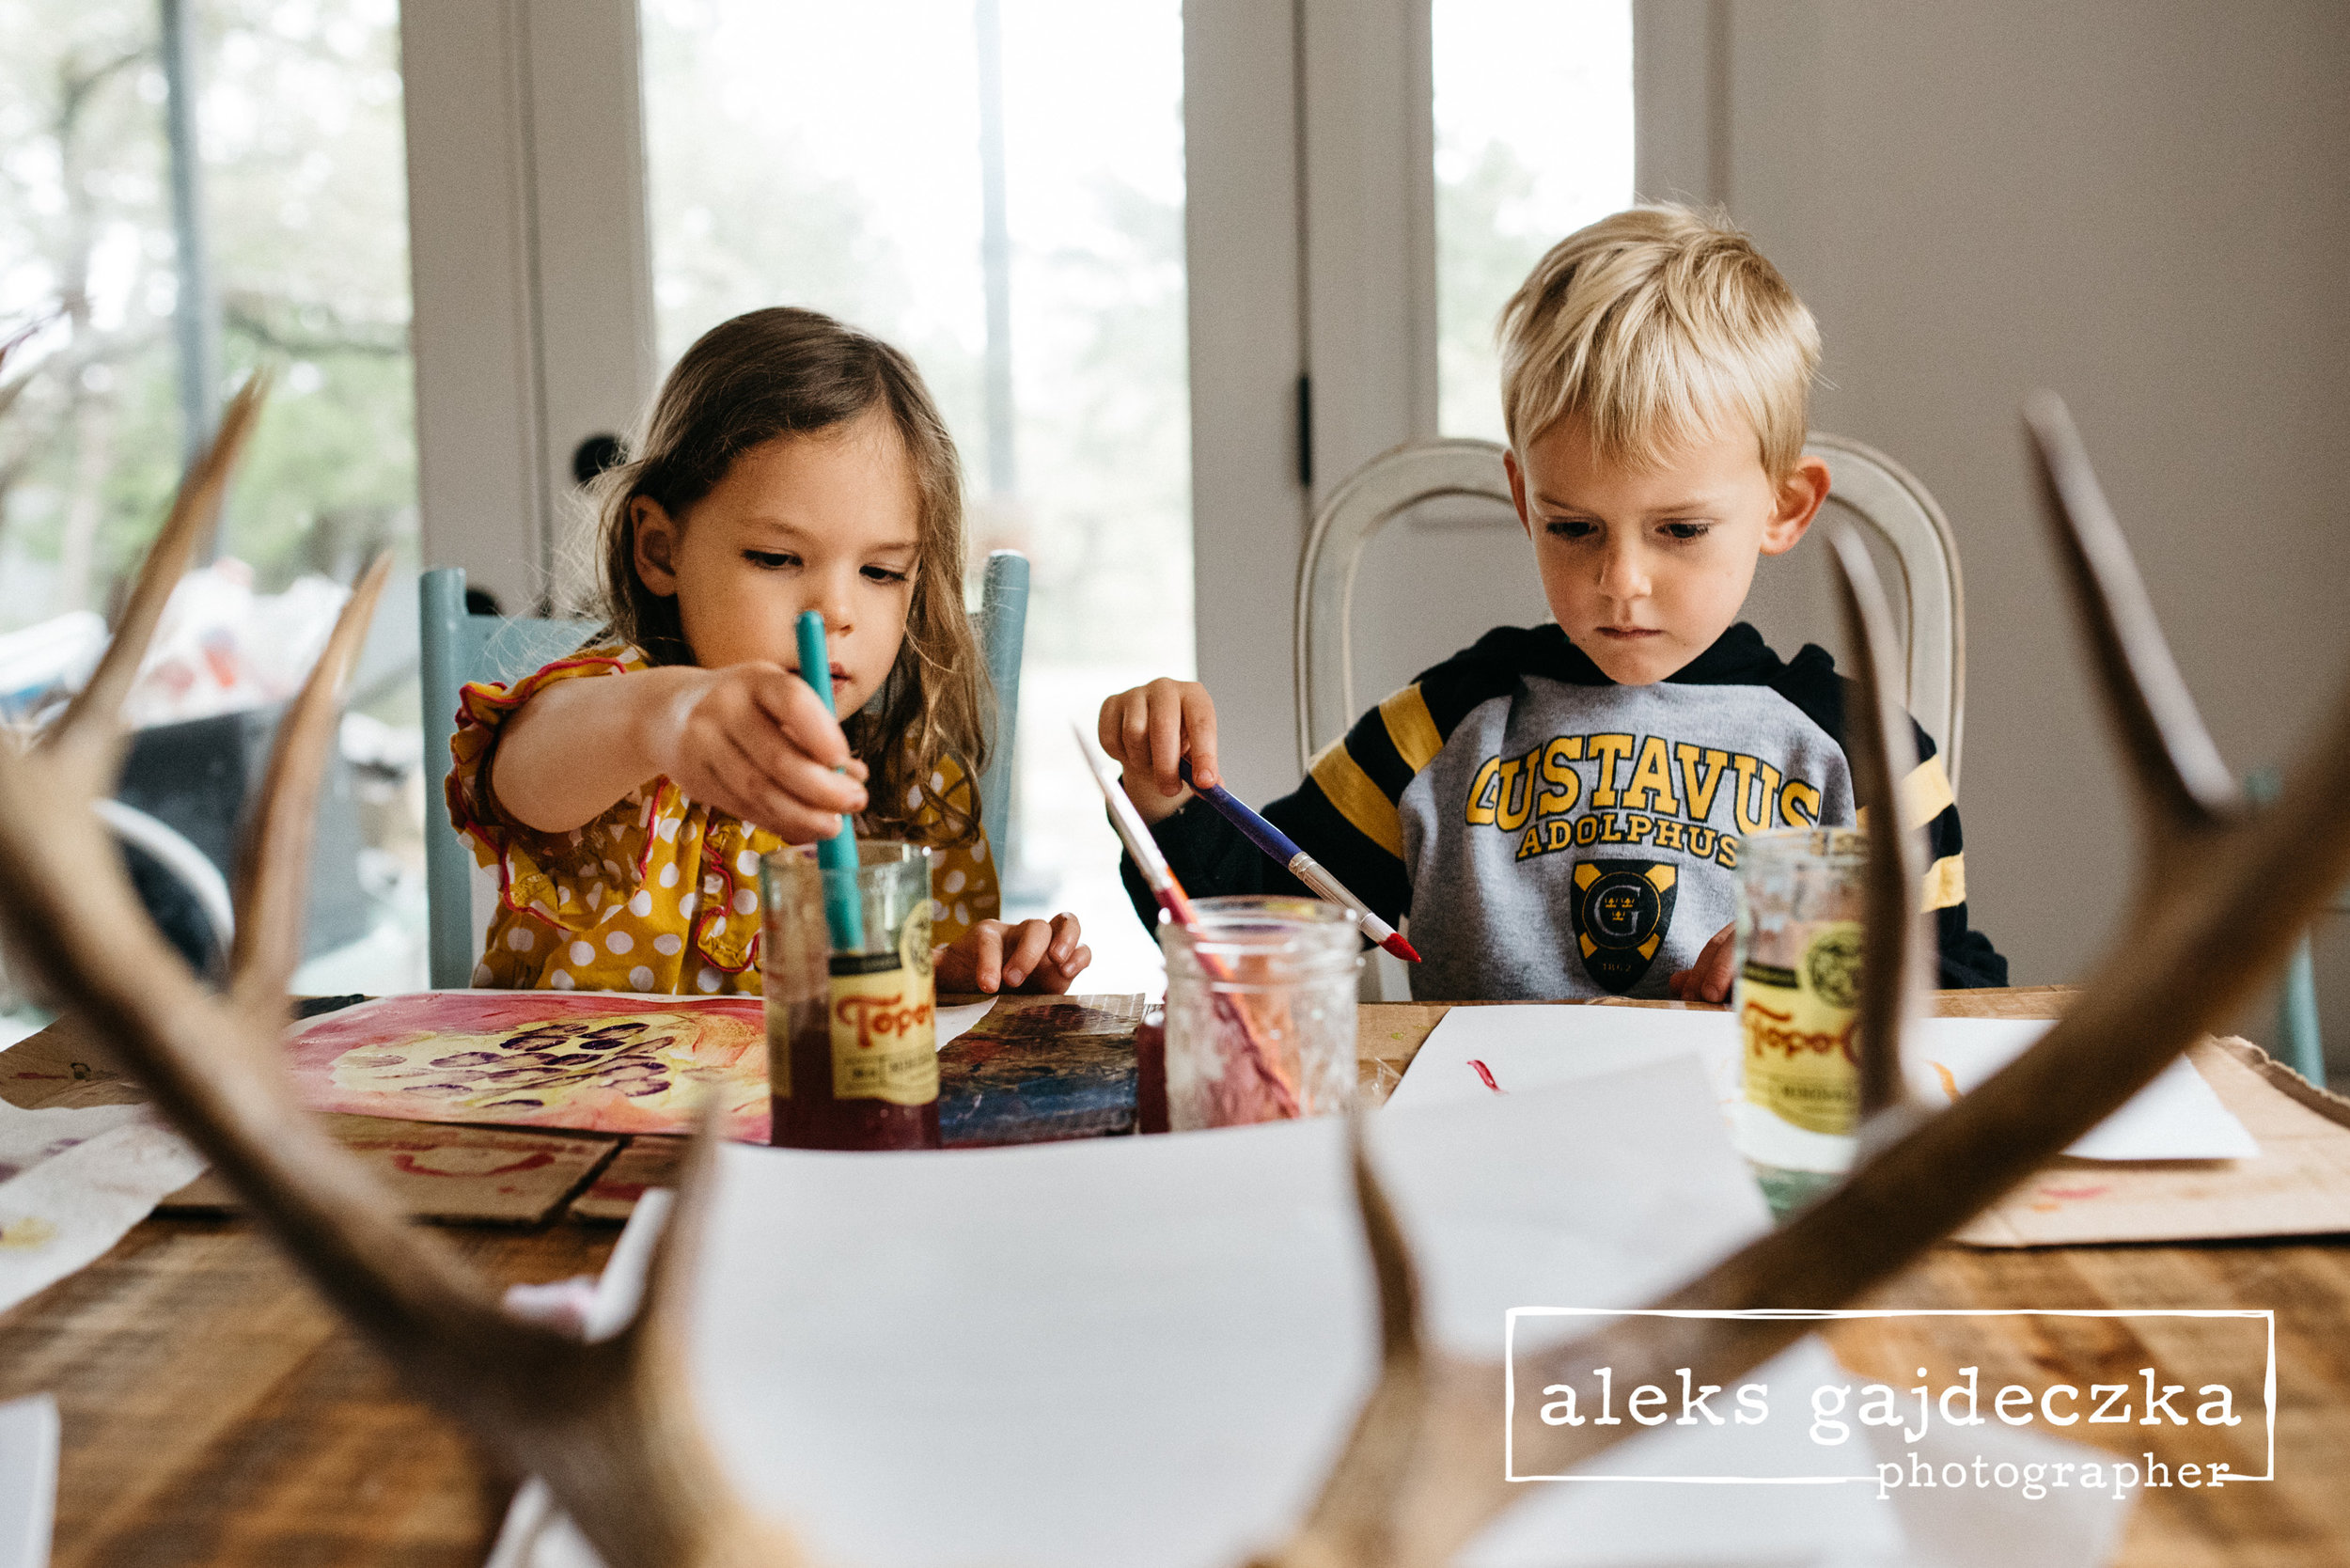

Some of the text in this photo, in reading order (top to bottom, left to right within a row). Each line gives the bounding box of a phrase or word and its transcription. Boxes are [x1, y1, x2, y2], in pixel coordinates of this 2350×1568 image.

[1465, 732, 1821, 836] GUSTAVUS
[1515, 812, 1741, 870] ADOLPHUS
[1593, 885, 1641, 937] G
